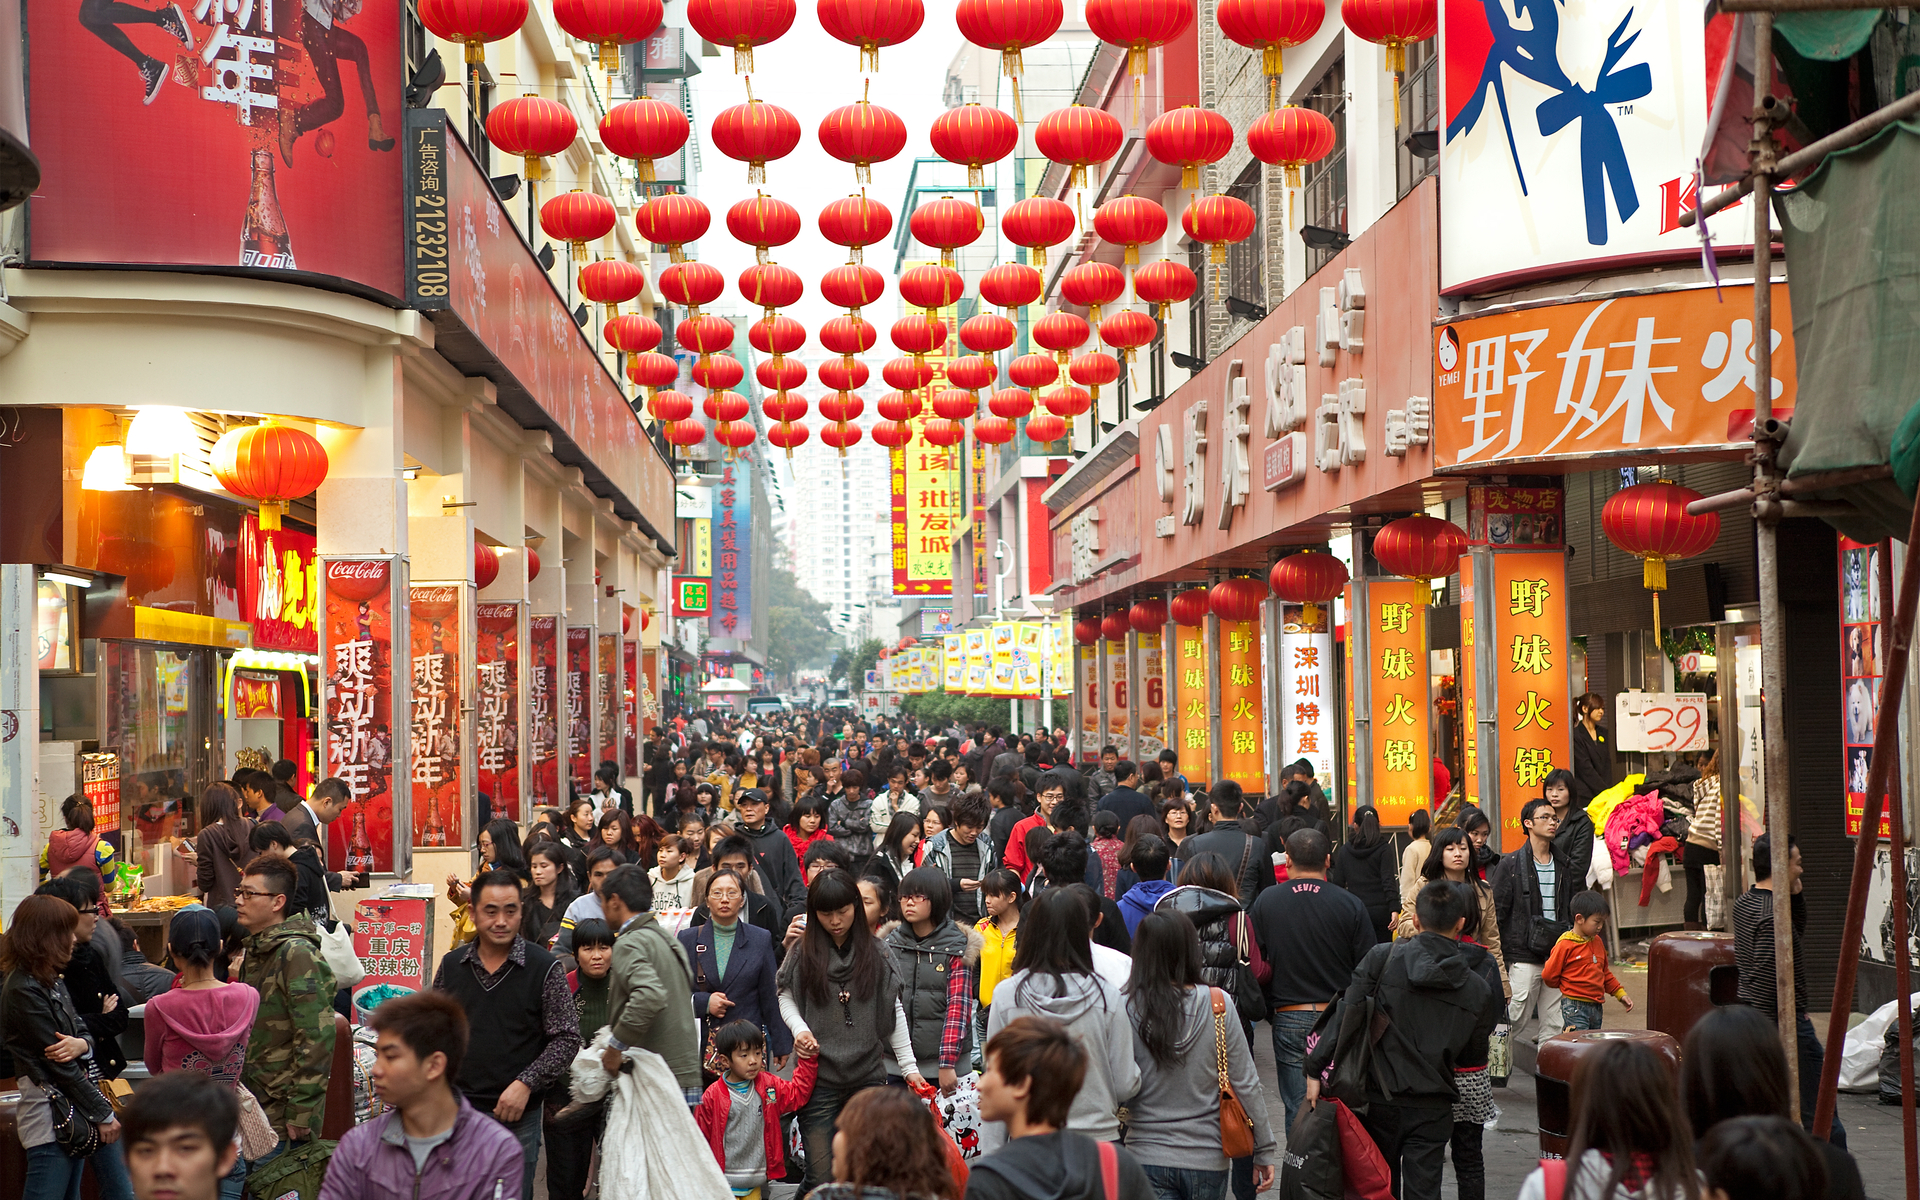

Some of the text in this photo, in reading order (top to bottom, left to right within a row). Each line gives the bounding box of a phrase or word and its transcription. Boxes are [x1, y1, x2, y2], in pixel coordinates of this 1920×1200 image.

[1617, 105, 1634, 116] TM
[415, 195, 449, 296] 21232108
[1438, 370, 1460, 387] YEMEI
[1488, 489, 1558, 509] 宠物店
[912, 559, 952, 576] 欢迎光
[1229, 630, 1256, 755] 野妹火锅
[1380, 602, 1417, 772] 野妹火锅
[1509, 578, 1556, 787] 野妹火锅
[1183, 639, 1206, 750] 野妹火锅
[410, 652, 447, 789] 爽动新年
[1643, 705, 1701, 752] 39
[1292, 883, 1321, 894] LEVI'S
[357, 922, 422, 936] 天下第一粉
[369, 937, 410, 956] 重庆
[358, 957, 419, 976] 酸辣粉
